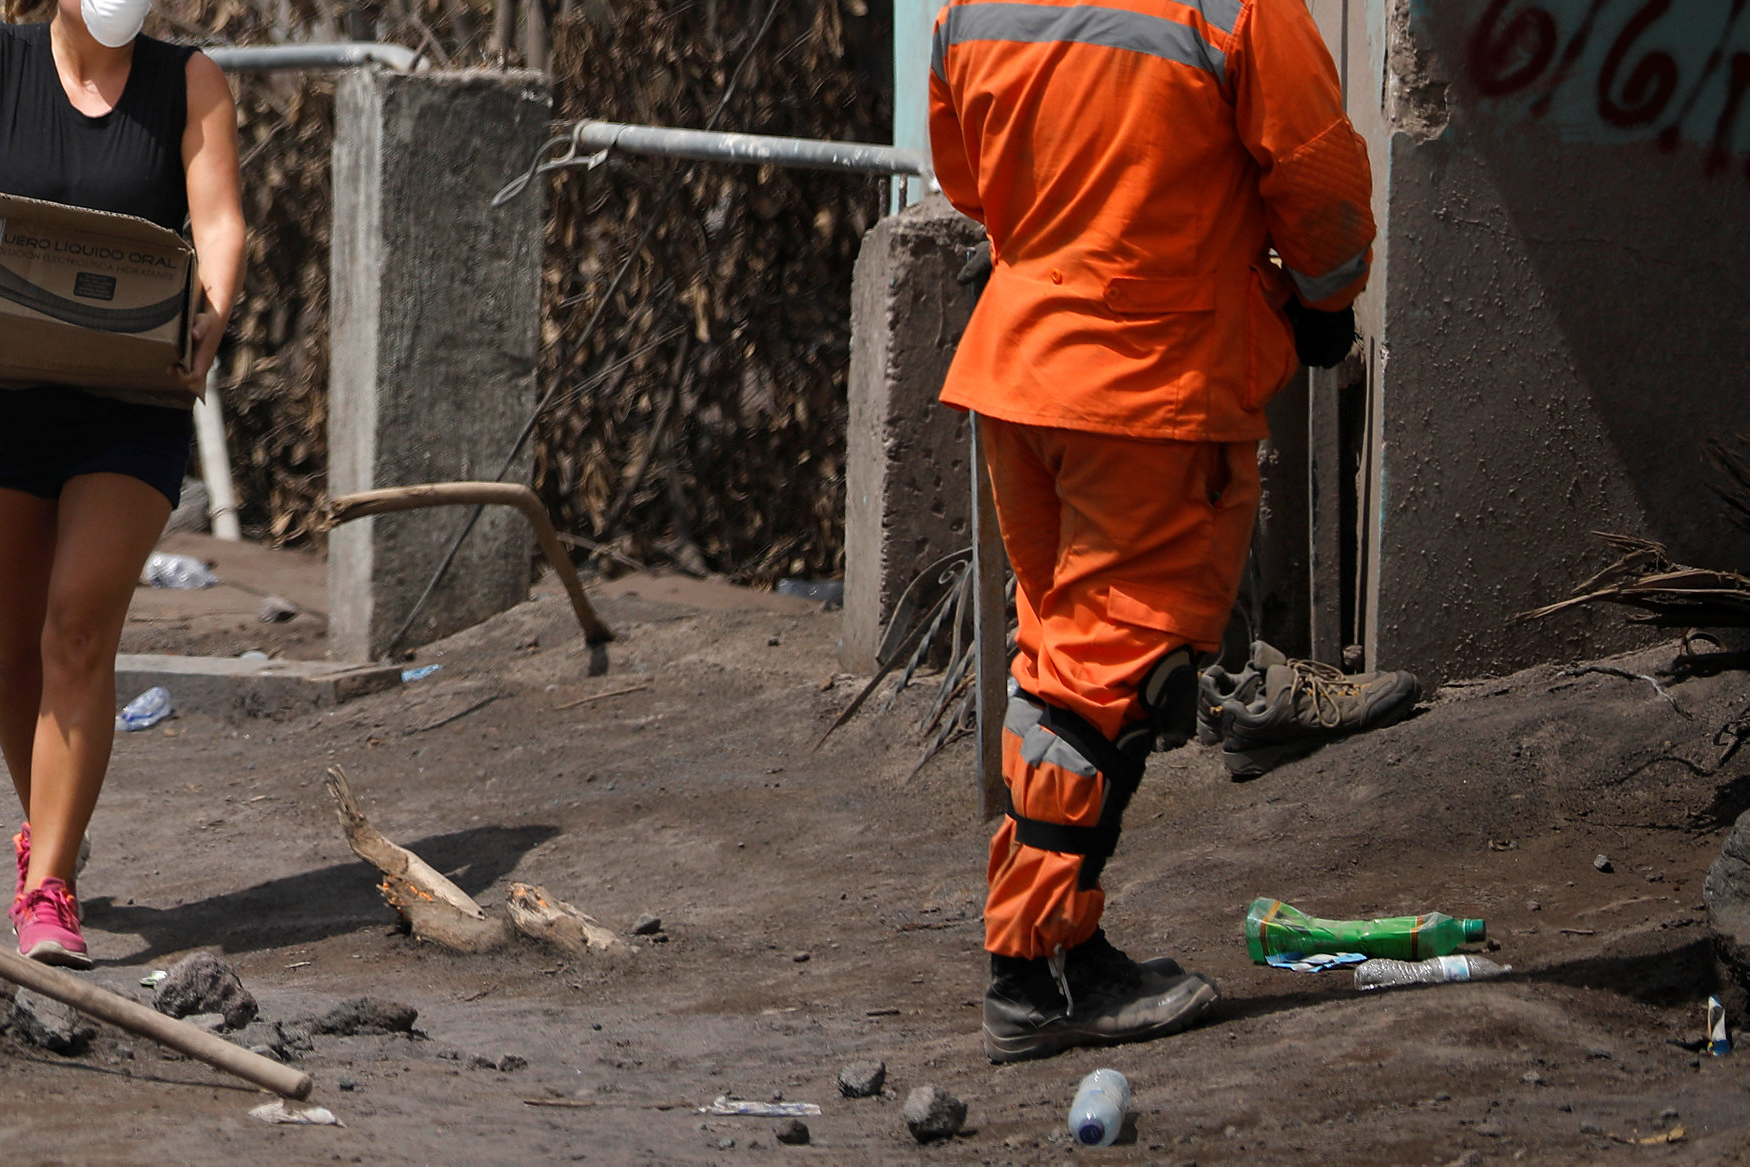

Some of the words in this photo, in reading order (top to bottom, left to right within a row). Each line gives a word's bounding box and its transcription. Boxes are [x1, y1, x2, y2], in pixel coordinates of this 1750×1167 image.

[2, 232, 50, 249] UERO
[54, 240, 124, 260] LIQUIDO
[129, 252, 176, 269] ORAL
